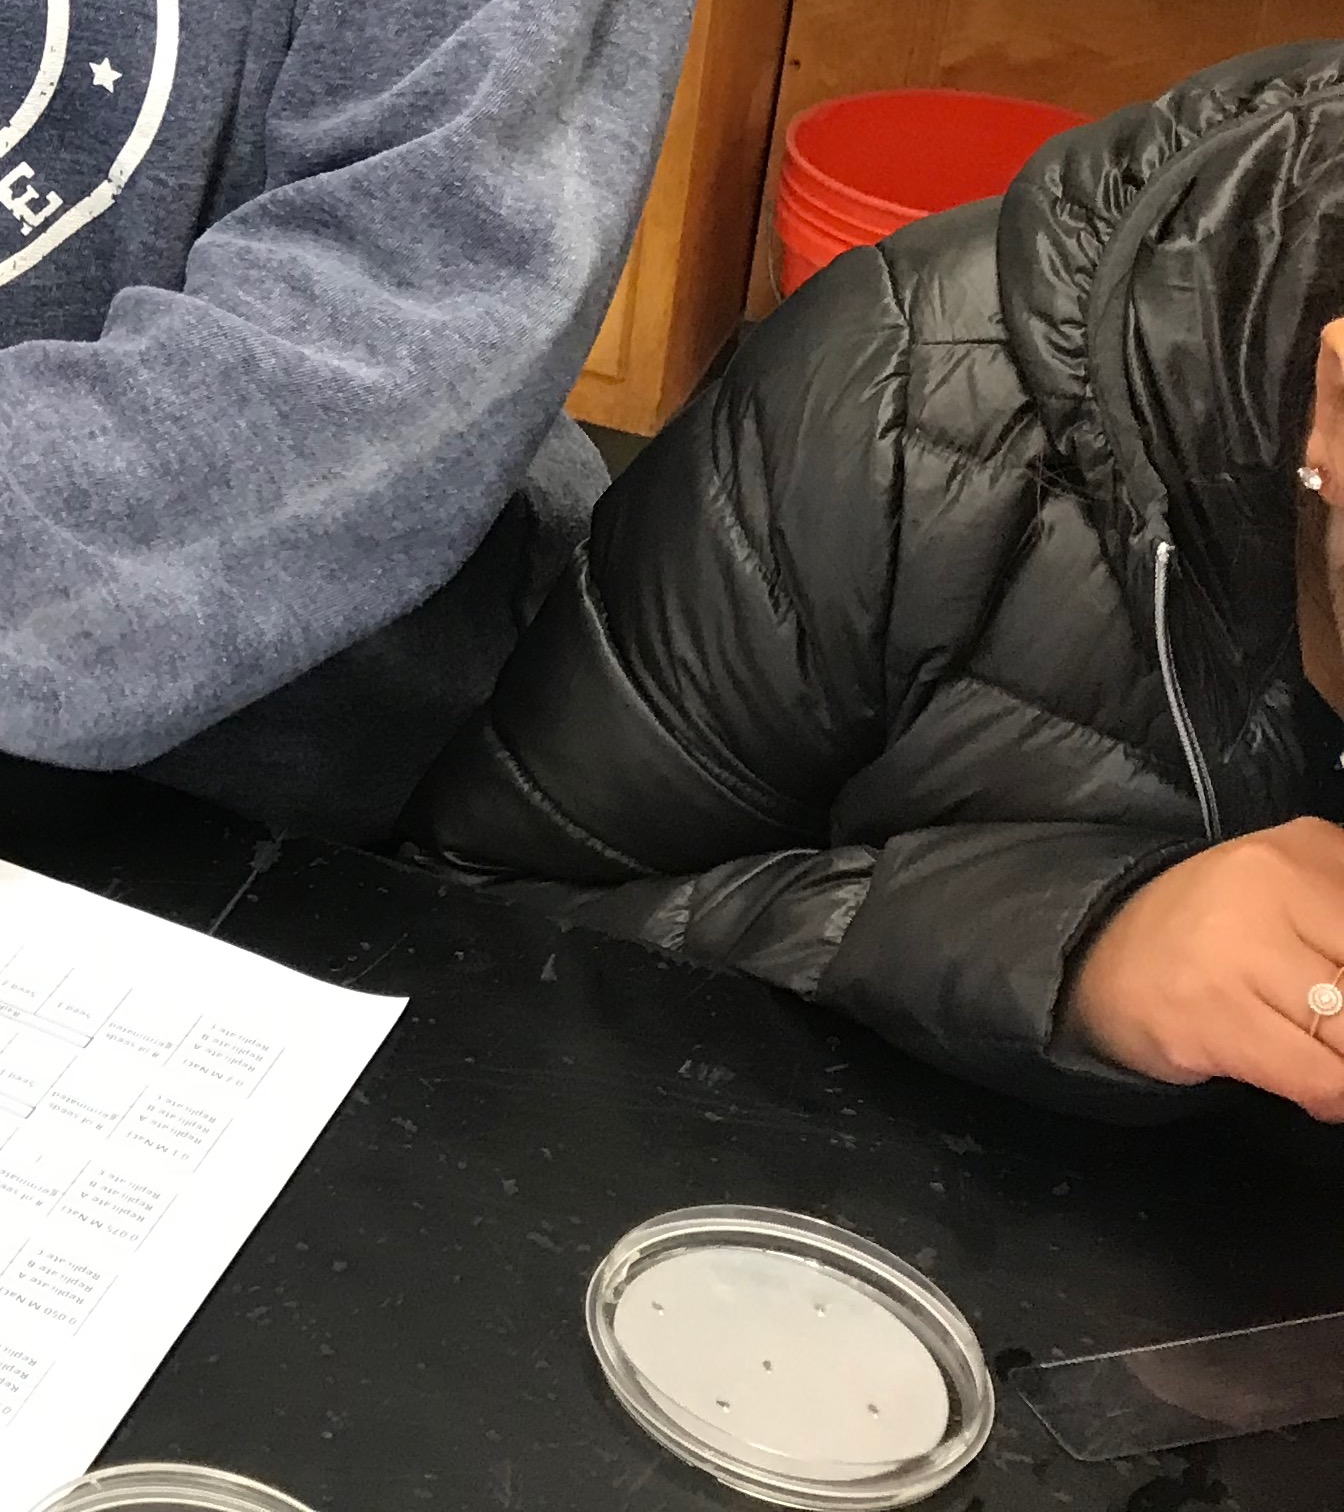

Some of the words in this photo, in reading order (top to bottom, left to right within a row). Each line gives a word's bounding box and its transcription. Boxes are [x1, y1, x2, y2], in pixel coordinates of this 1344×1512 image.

[171, 1149, 189, 1160] 01
[106, 1224, 139, 1241] 0075
[42, 1306, 77, 1325] 0050
